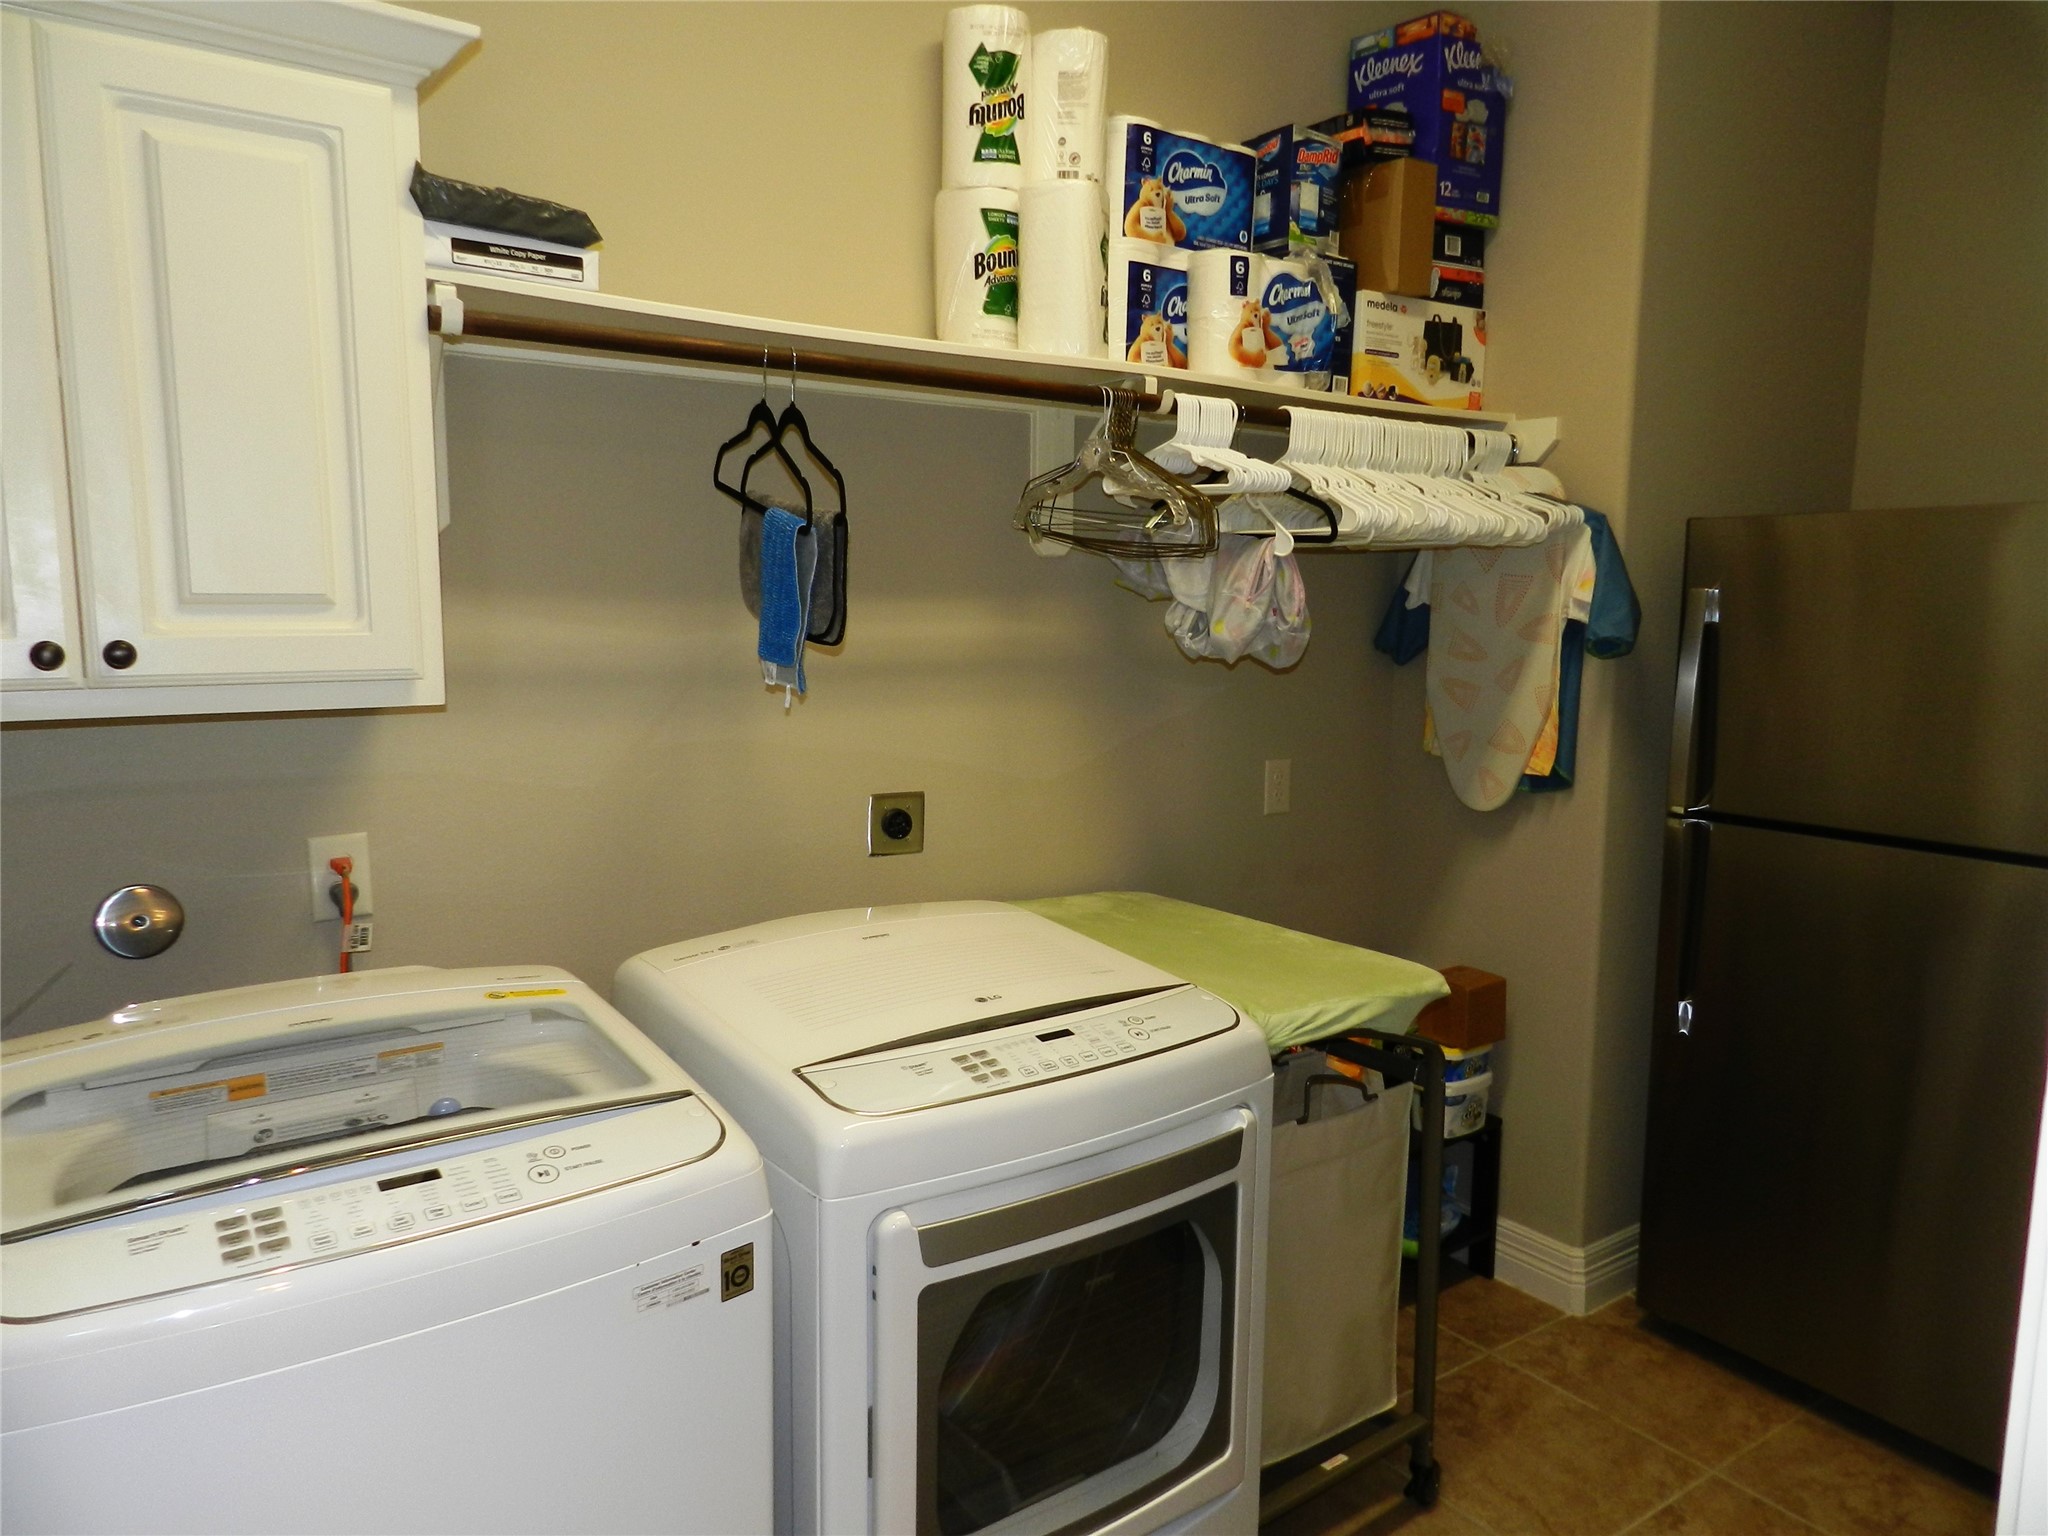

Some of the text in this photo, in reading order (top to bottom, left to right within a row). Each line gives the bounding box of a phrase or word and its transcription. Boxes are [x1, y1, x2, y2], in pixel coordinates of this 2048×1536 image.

[1354, 53, 1424, 93] Kleenex
[1368, 82, 1405, 100] ultra soft
[968, 93, 1025, 127] Bounty
[1143, 131, 1152, 145] 6
[1296, 146, 1340, 167] DampRid
[1168, 162, 1213, 184] Charmin
[1440, 181, 1452, 196] 12
[1184, 193, 1220, 205] Ultra Soft
[489, 246, 547, 261] White Copy Paper
[974, 248, 1018, 280] Boun
[1235, 261, 1245, 275] 6
[1143, 268, 1152, 282] 6
[1366, 299, 1398, 313] medela
[367, 1113, 390, 1123] LG
